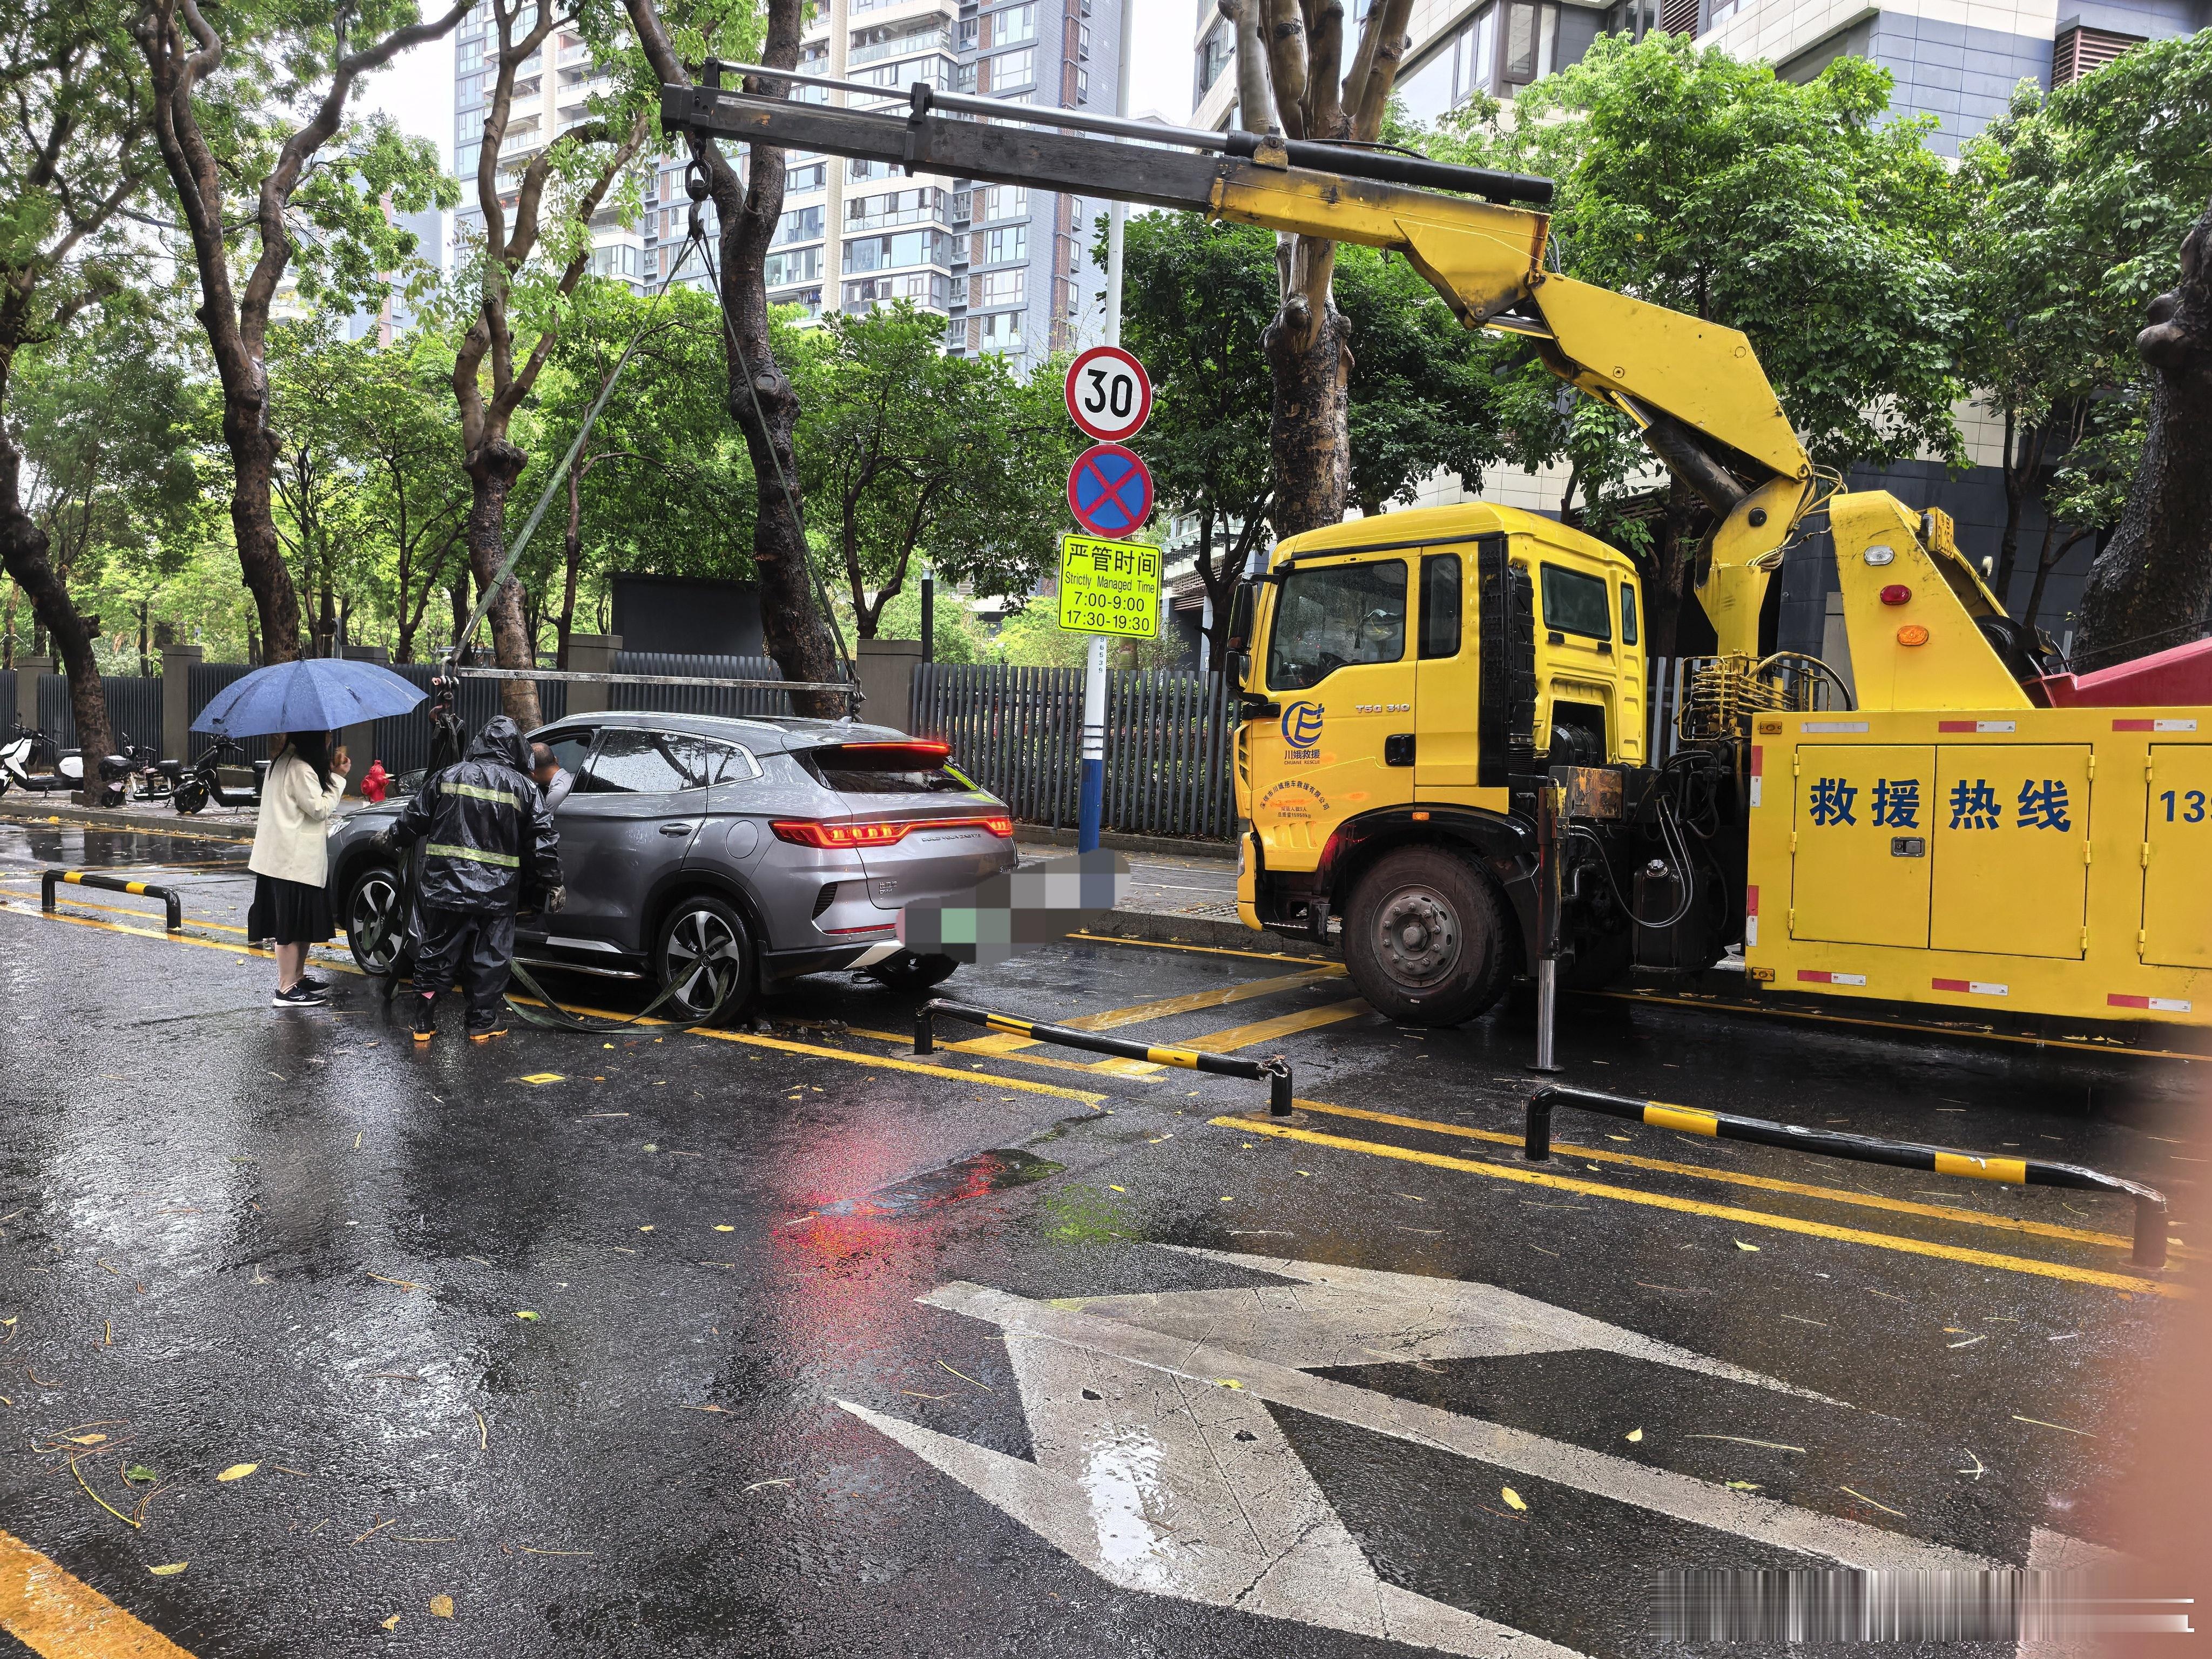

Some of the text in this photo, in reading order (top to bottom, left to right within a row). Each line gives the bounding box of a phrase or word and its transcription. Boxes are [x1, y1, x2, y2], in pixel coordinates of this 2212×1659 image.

[1085, 368, 1132, 417] 30
[1066, 543, 1156, 578] 严管时间
[1065, 571, 1155, 594] Strictly Managed Time
[1074, 591, 1144, 612] 7:00-9:00
[1066, 610, 1149, 631] 17:30-19:30
[1355, 703, 1411, 713] T5G 310
[1809, 777, 2072, 833] 救援热线
[2160, 790, 2212, 823] 13
